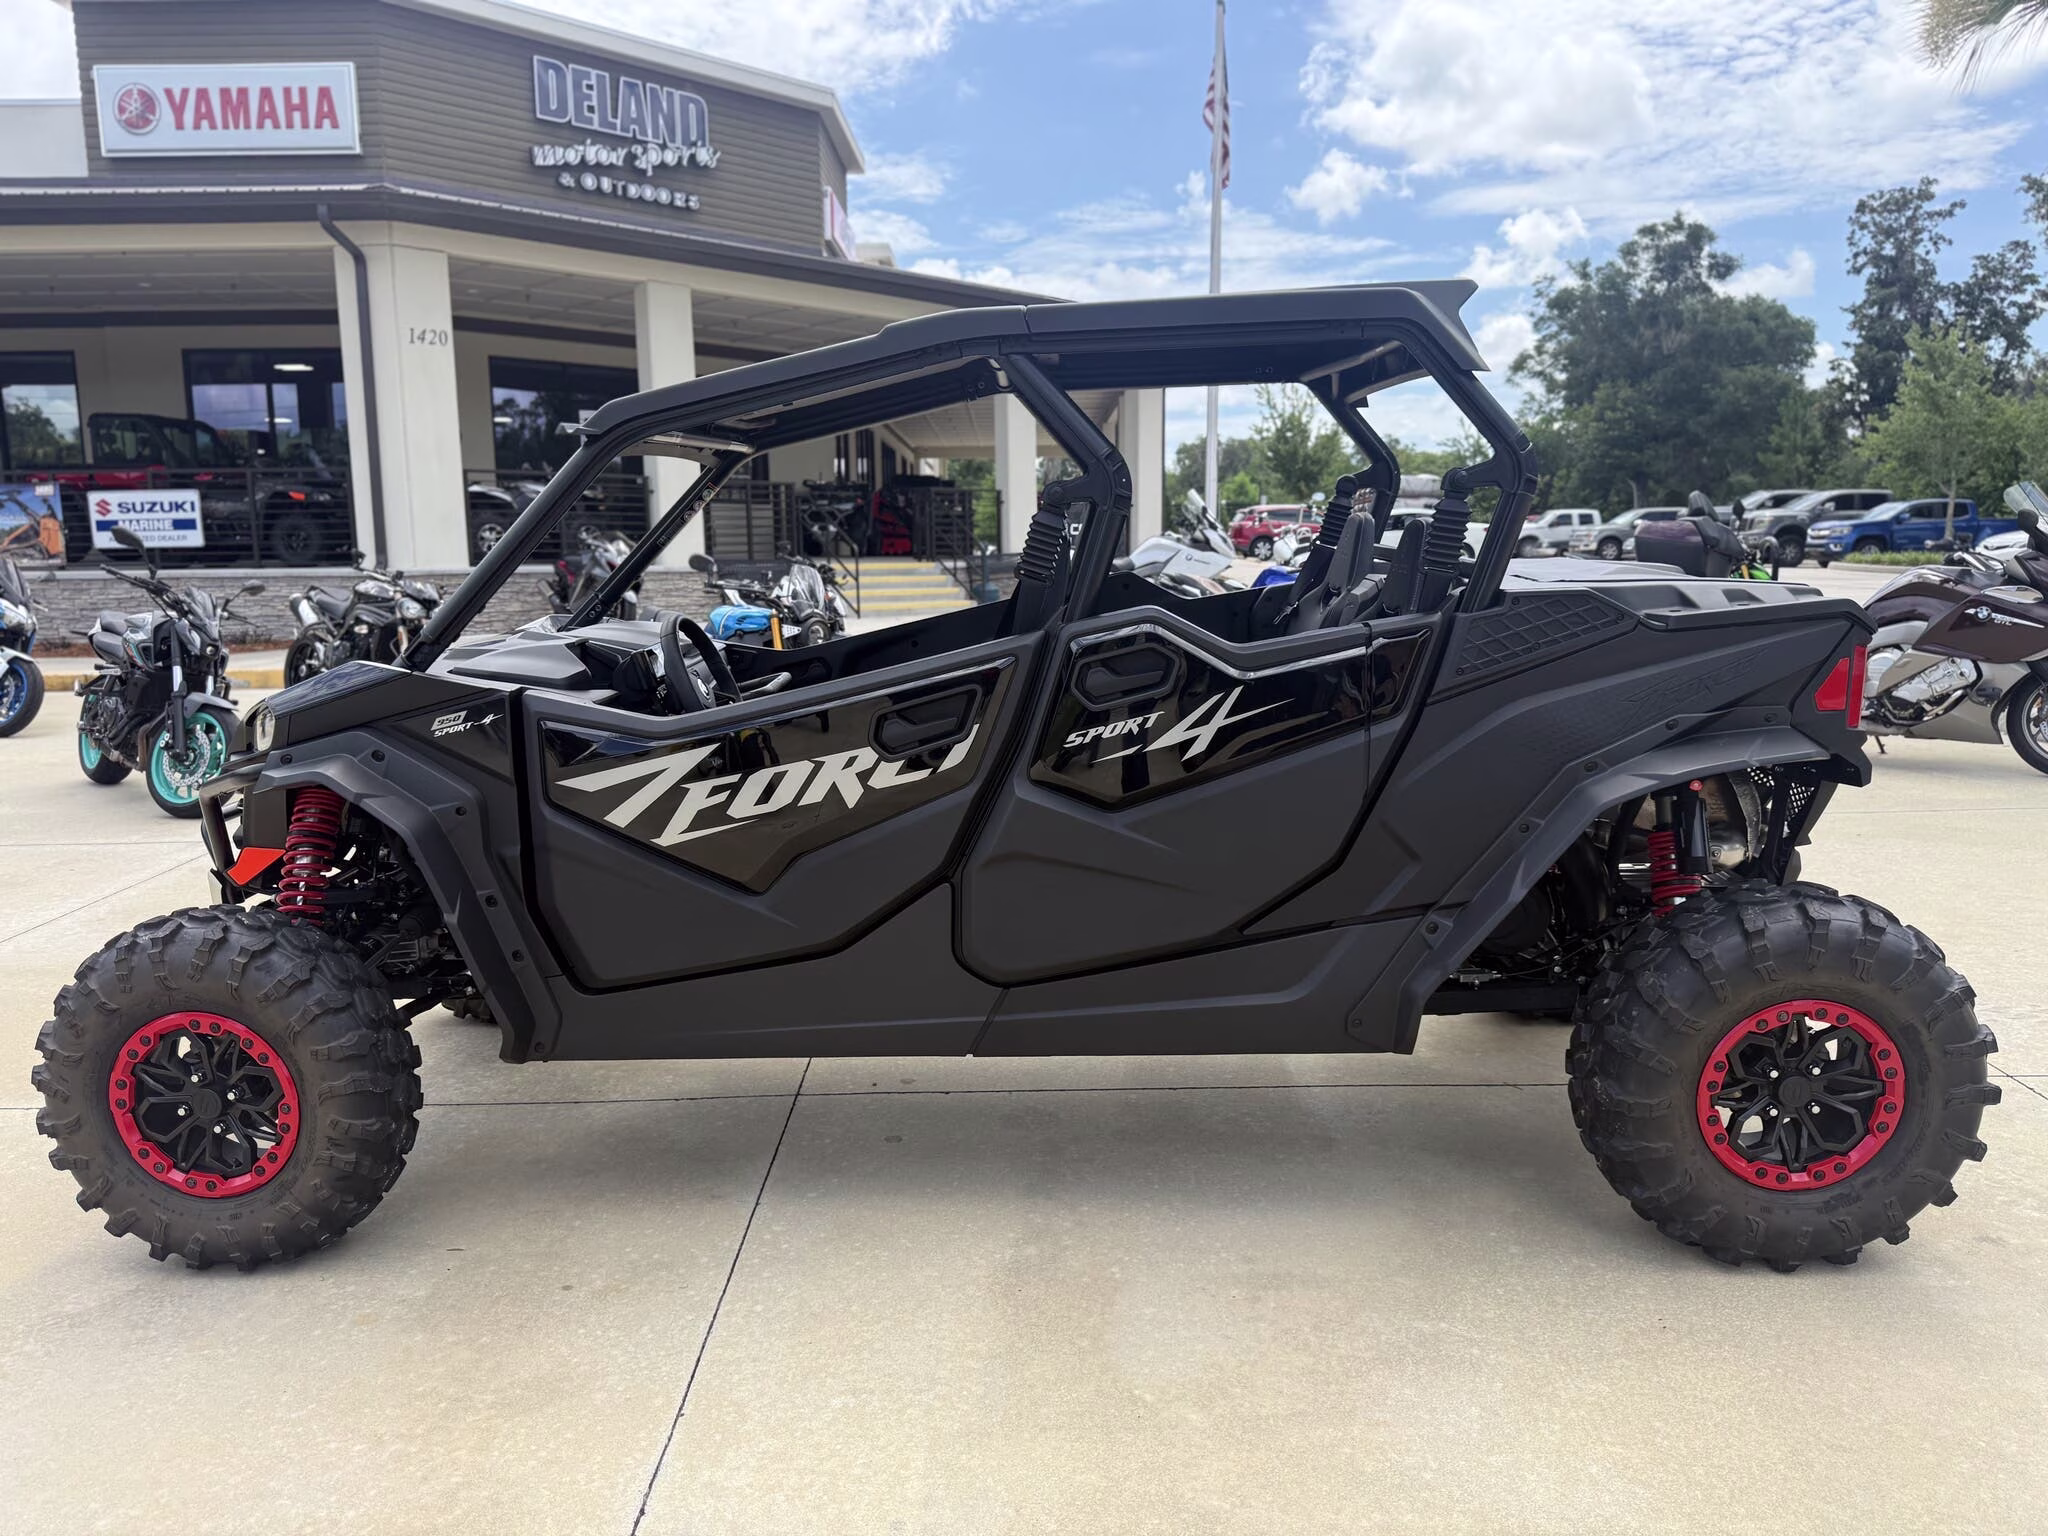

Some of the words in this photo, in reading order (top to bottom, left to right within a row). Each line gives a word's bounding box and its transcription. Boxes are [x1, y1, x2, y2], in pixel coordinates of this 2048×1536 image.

[164, 86, 340, 130] YAMAHA
[533, 55, 709, 149] DELAND
[559, 172, 575, 188] &
[408, 327, 448, 346] 1420
[117, 501, 196, 514] SUZUKI
[117, 519, 174, 532] MARINE
[158, 534, 188, 542] DEALER
[1063, 711, 1166, 748] SPORT
